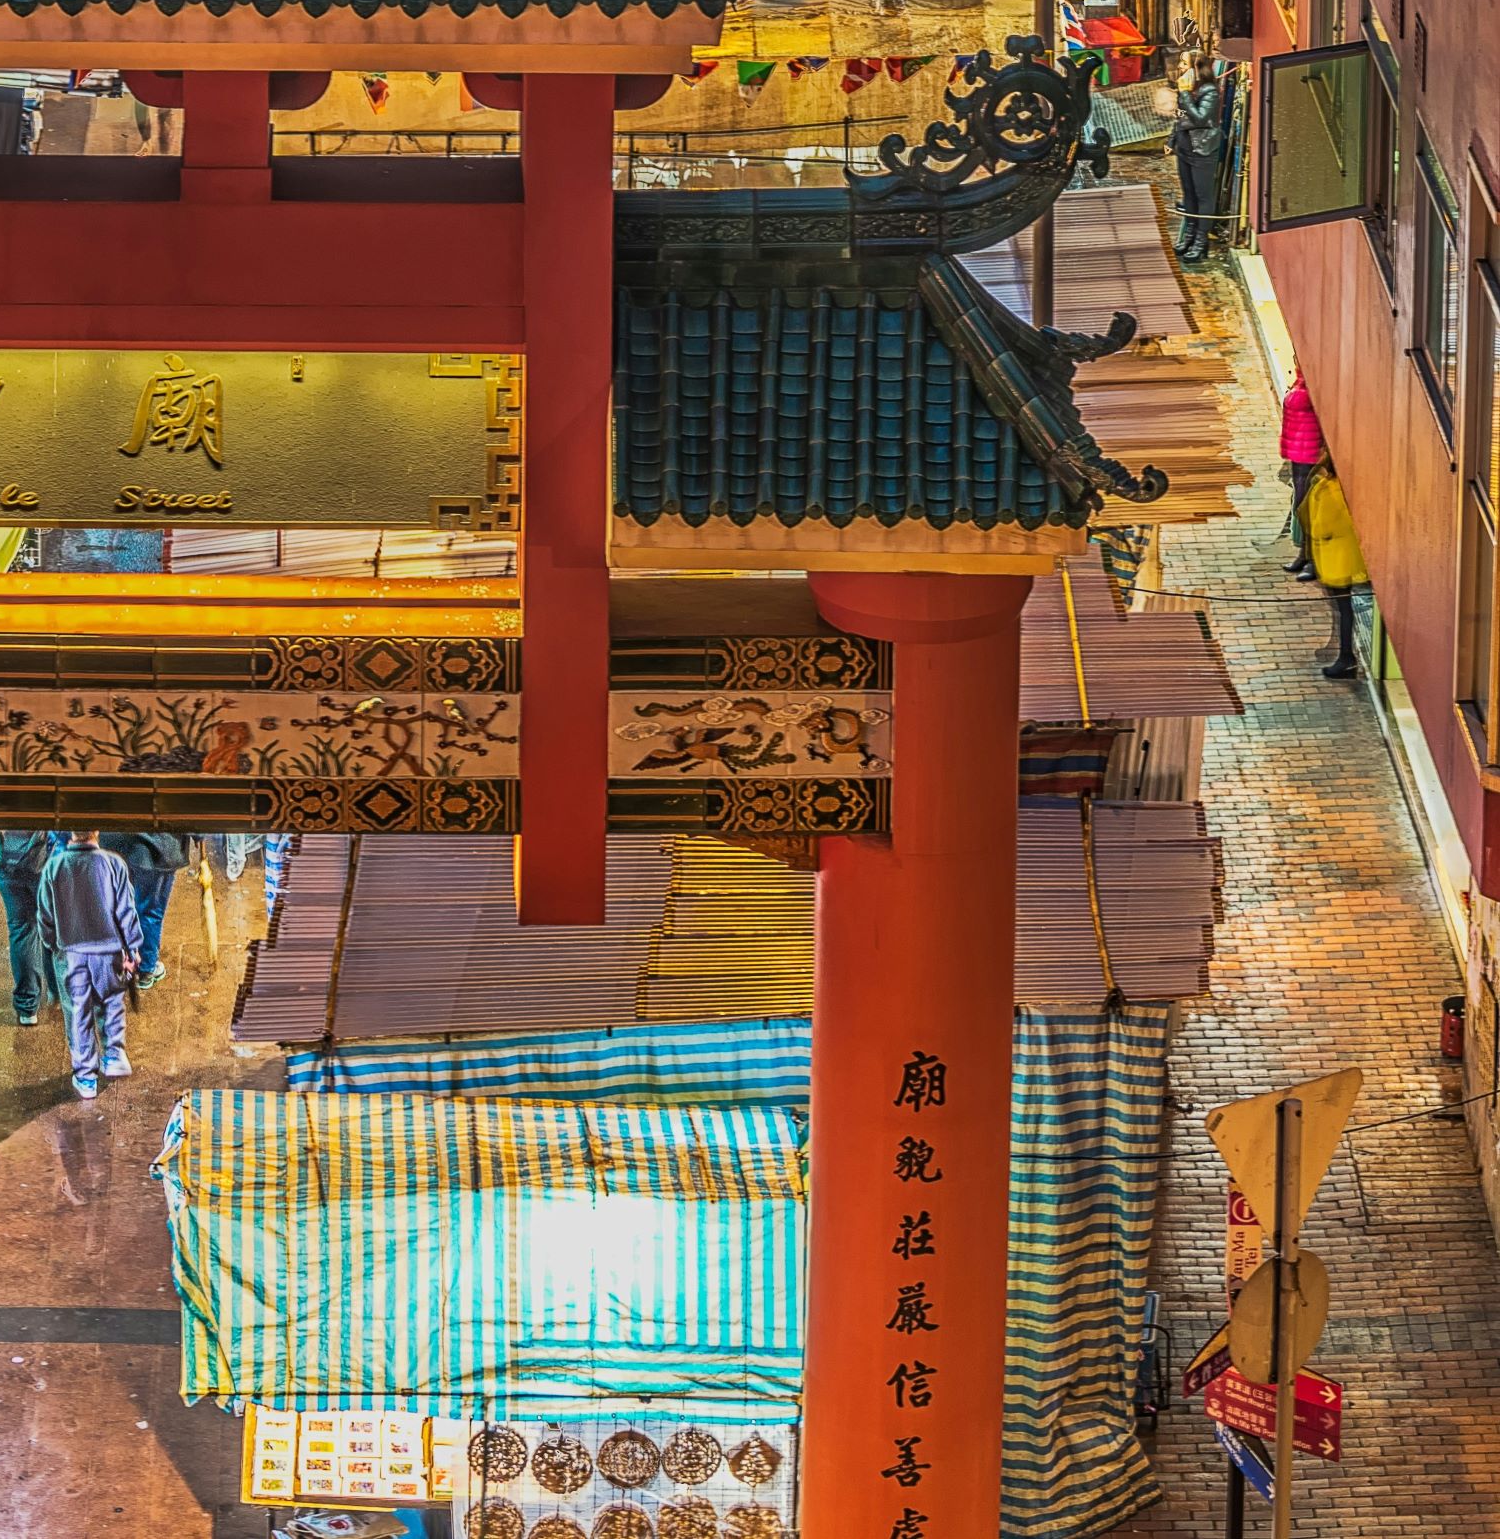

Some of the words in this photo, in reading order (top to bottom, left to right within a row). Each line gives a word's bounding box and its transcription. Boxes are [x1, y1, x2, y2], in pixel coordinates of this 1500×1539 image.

[114, 484, 234, 513] Street
[1234, 1230, 1246, 1252] Ma
[1245, 1246, 1259, 1268] Tei
[1229, 1256, 1245, 1285] Yau
